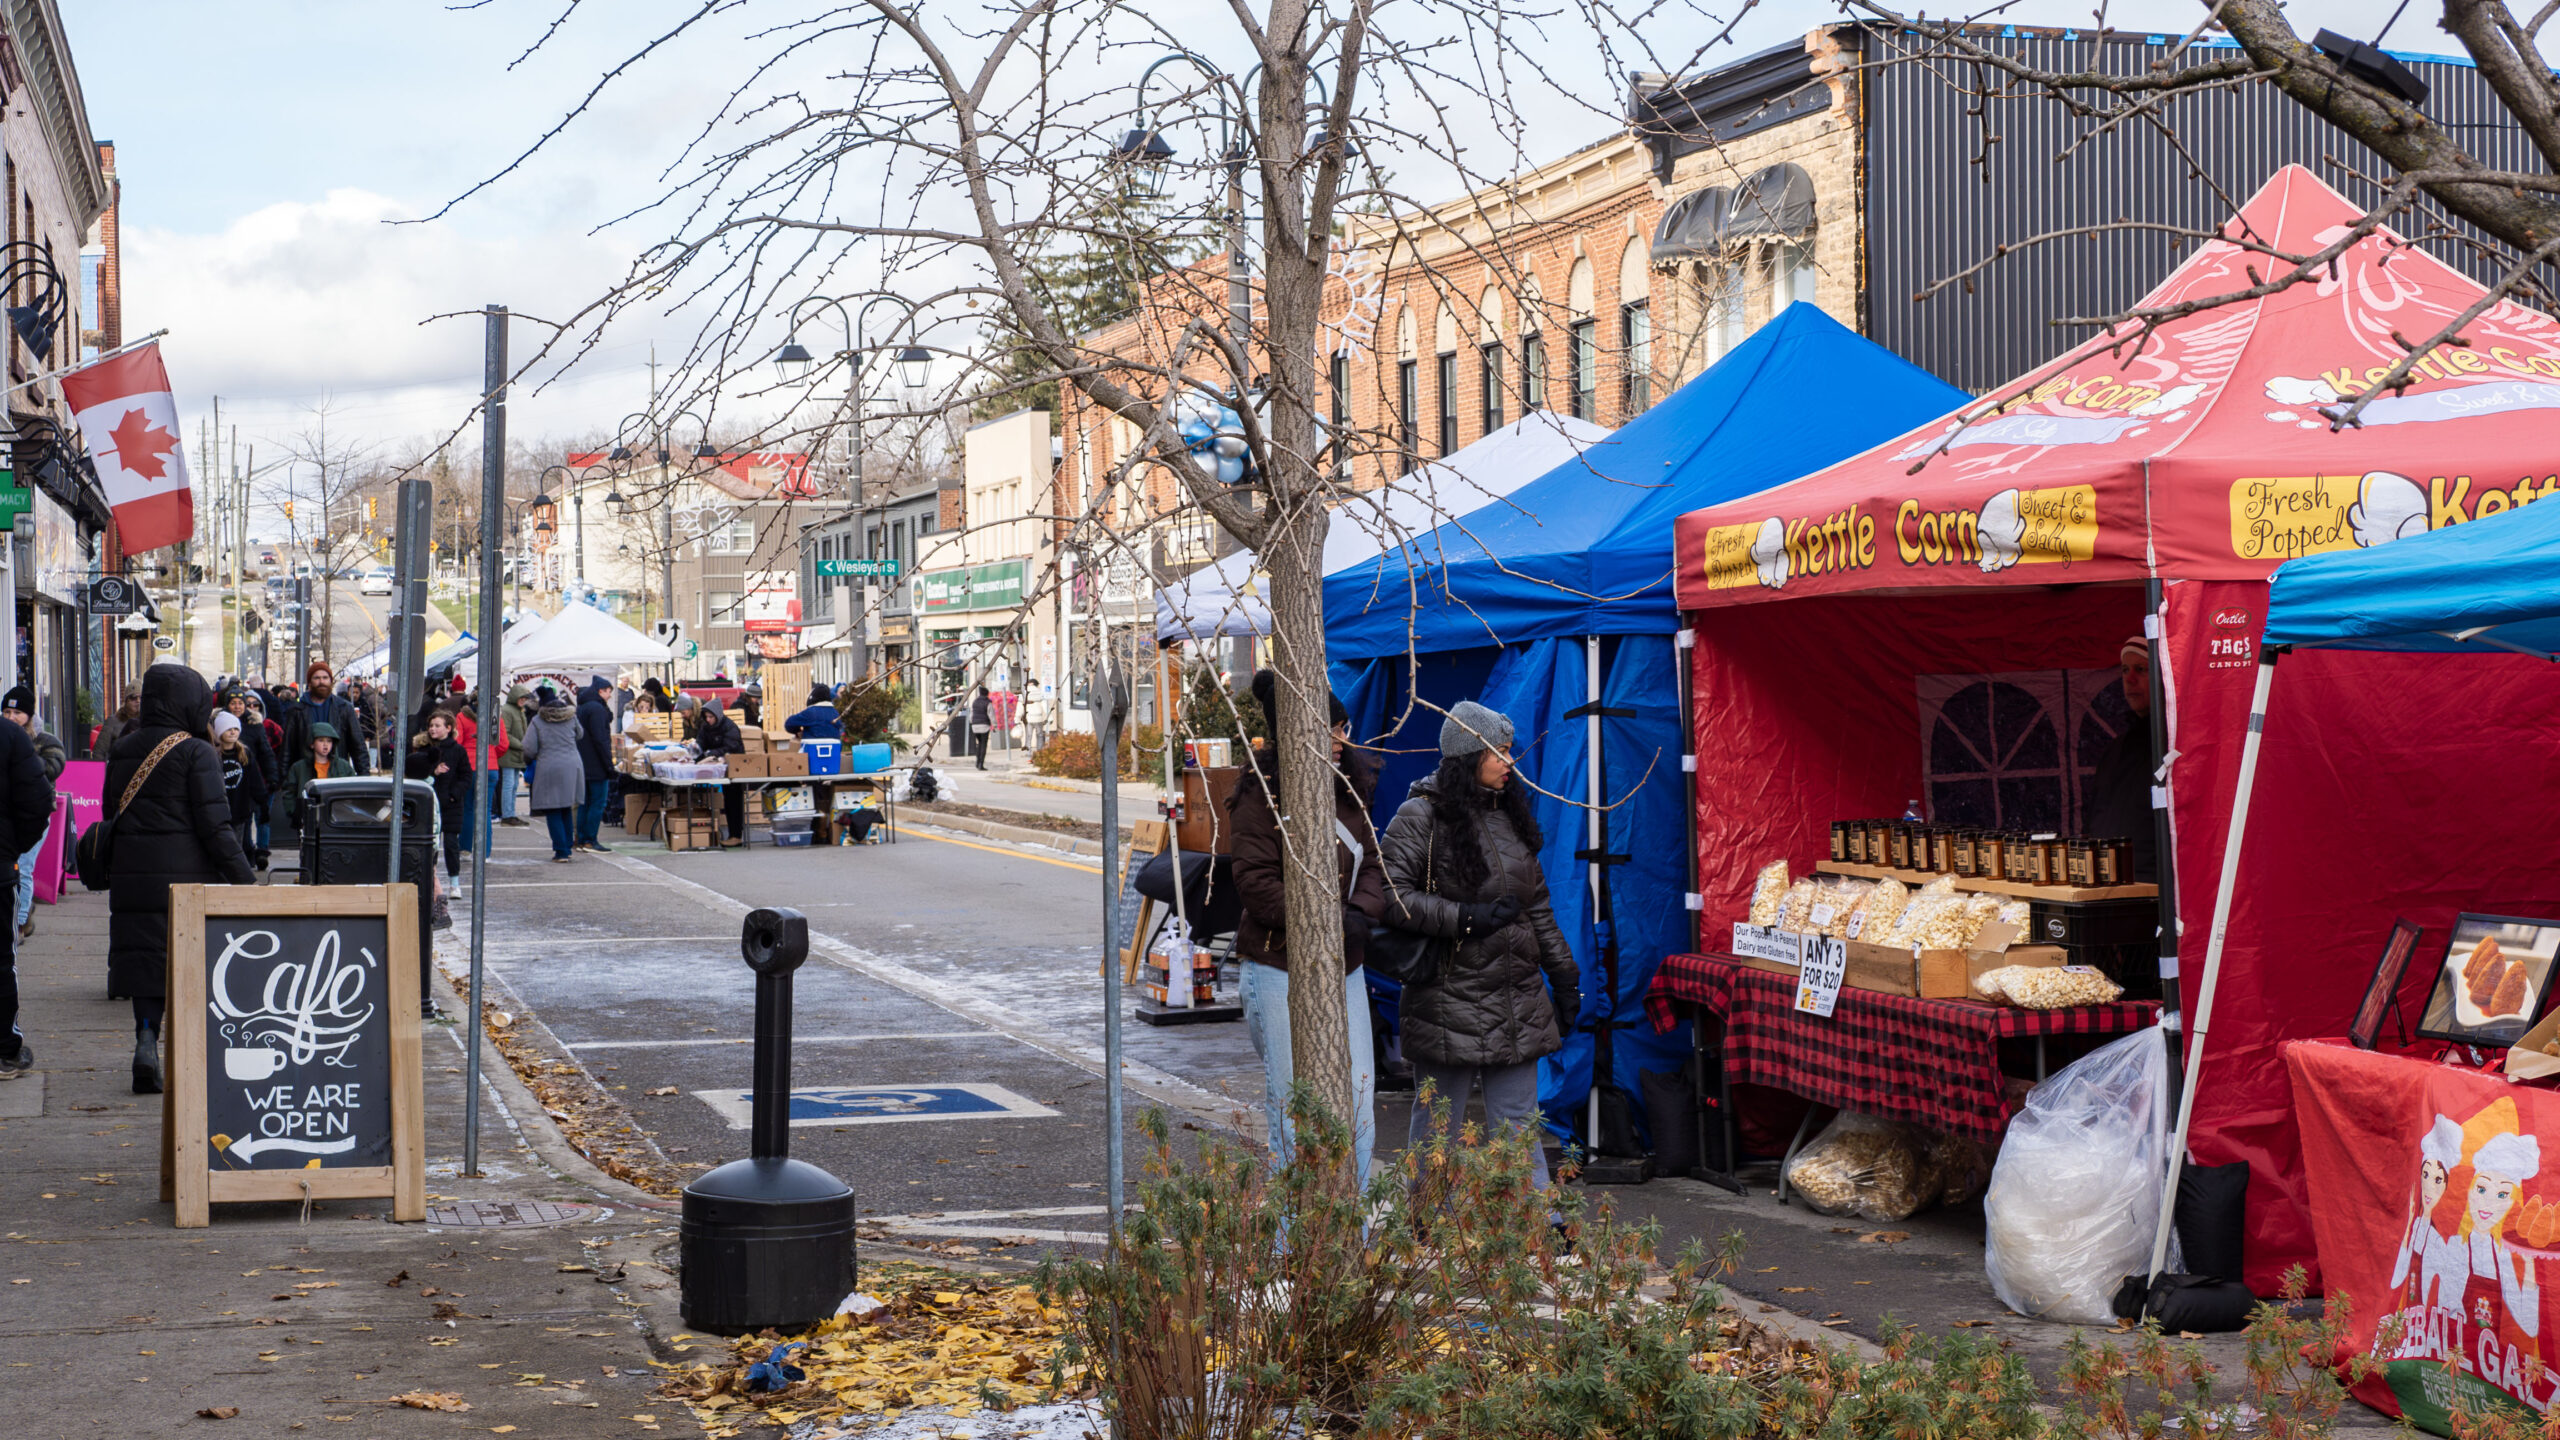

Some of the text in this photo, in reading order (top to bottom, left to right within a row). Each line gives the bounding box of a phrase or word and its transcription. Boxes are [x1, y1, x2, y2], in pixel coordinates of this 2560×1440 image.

[2320, 349, 2489, 395] Ketle
[2063, 376, 2161, 411] Corn
[2436, 392, 2514, 413] Sweet
[2244, 472, 2333, 519] Fresh
[1711, 486, 2084, 577] Fresh Kettle Corn Sweet &
[2026, 519, 2073, 568] Salty
[2243, 506, 2345, 560] Popped
[836, 561, 895, 575] Wesleyan St
[2216, 613, 2246, 624] Outlet
[2211, 637, 2250, 655] TAGS
[1735, 925, 1748, 936] Our
[1751, 926, 1773, 941] Popcn
[1737, 940, 1756, 954] Dairy
[1757, 944, 1766, 953] and
[1768, 945, 1785, 958] Gluten
[1806, 939, 1843, 968] ANY 3
[1803, 967, 1840, 990] FOR $20
[244, 1084, 361, 1111] WE ARE
[260, 1112, 349, 1138] OPEN
[2371, 1304, 2474, 1373] CEBALL
[2422, 1379, 2451, 1409] RICE
